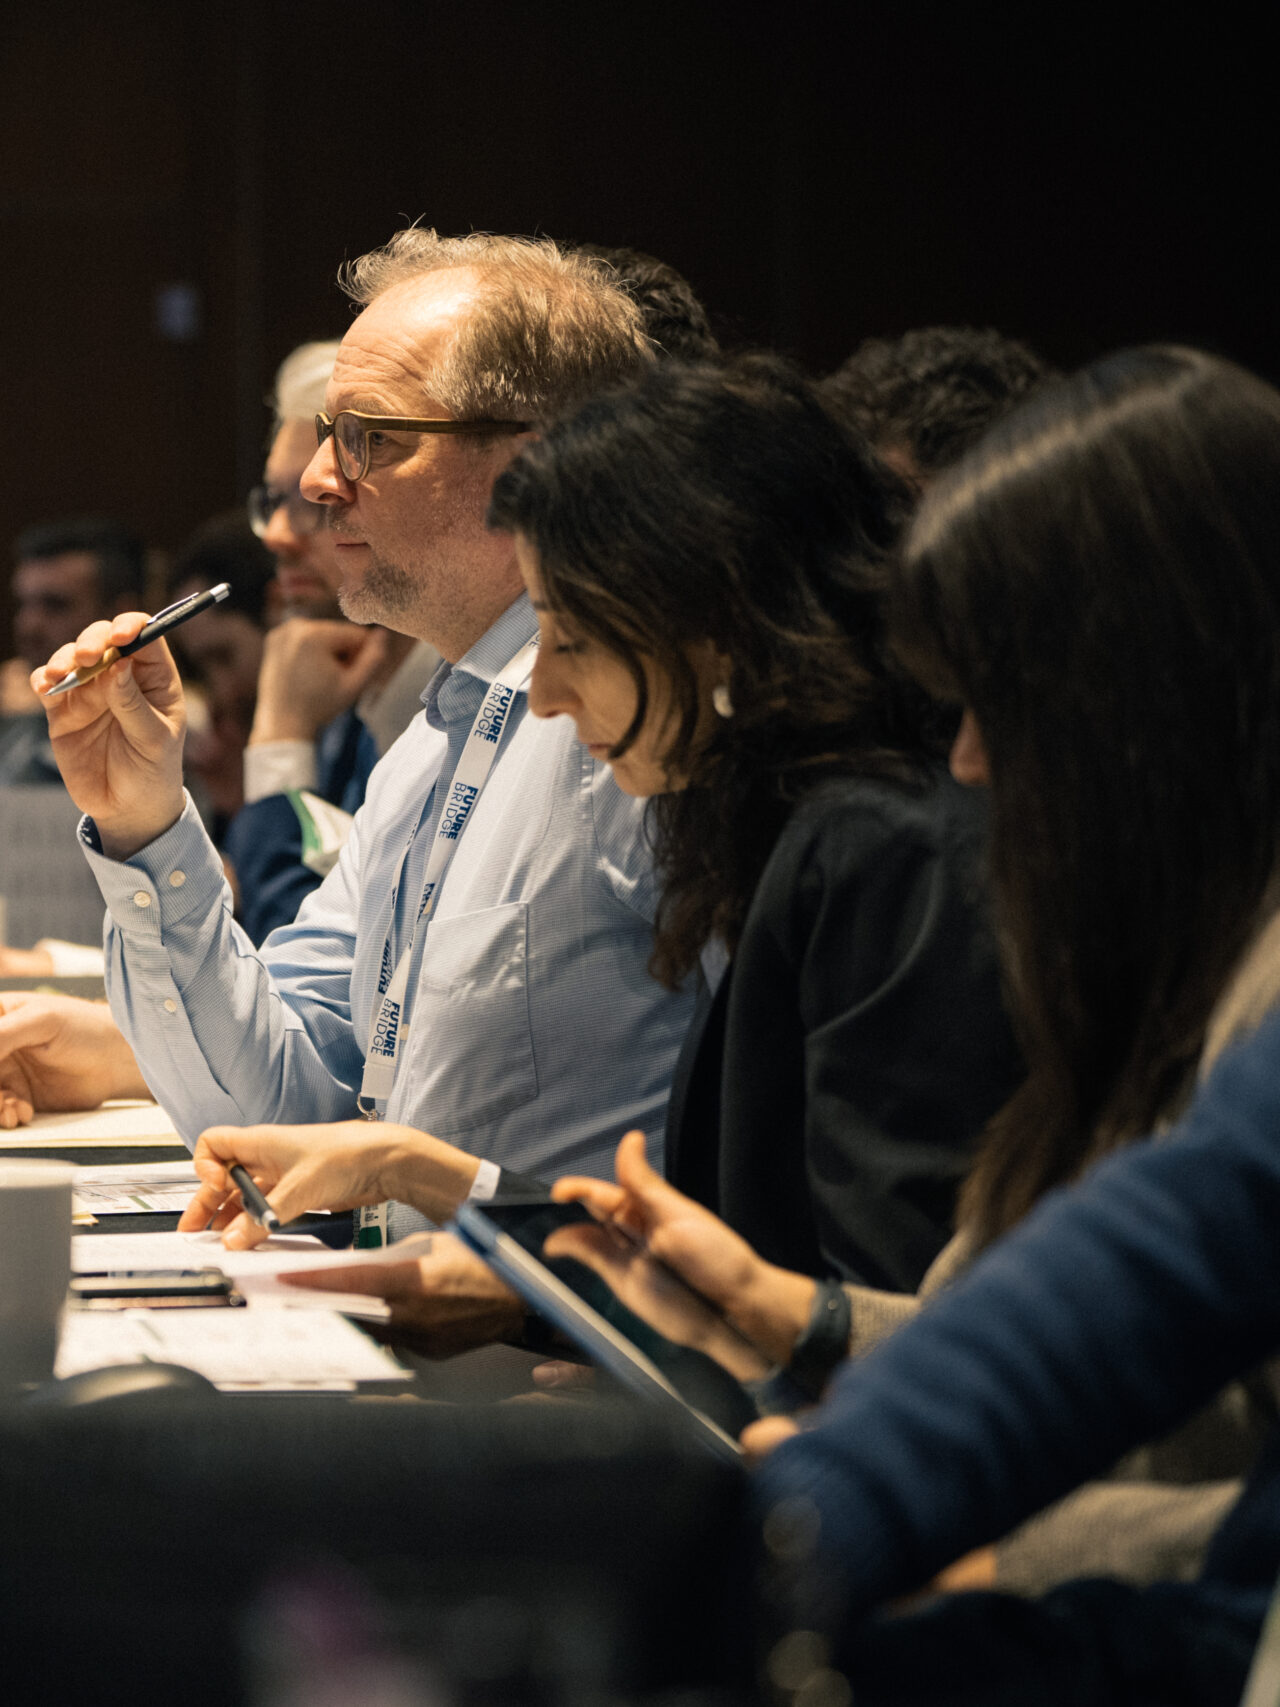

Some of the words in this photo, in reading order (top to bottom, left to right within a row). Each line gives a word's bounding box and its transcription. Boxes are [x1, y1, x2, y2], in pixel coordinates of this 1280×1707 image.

[474, 682, 505, 740] BRIDGE
[486, 687, 514, 744] FUTURE
[439, 782, 467, 838] BRIDGE
[447, 785, 479, 840] FUTURE
[370, 998, 392, 1055] BRIDGE
[383, 1002, 400, 1057] FUTURE
